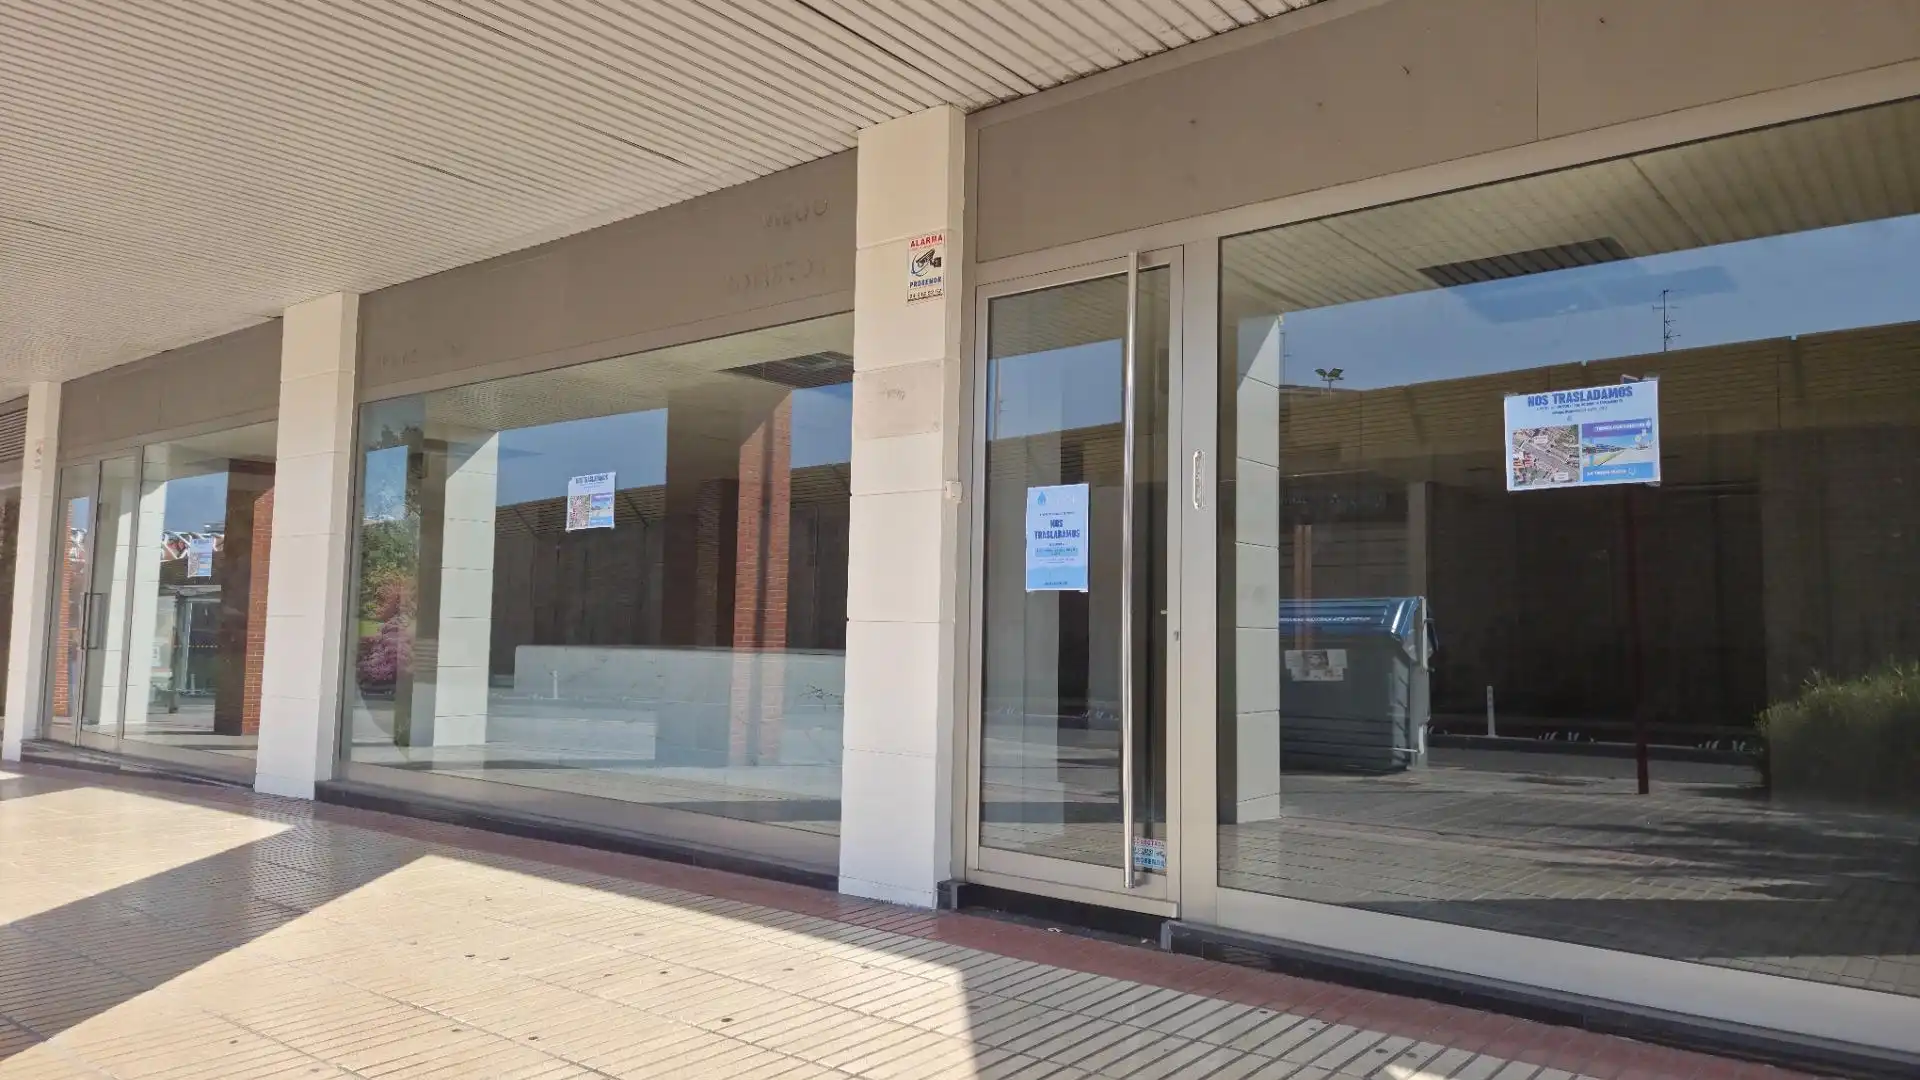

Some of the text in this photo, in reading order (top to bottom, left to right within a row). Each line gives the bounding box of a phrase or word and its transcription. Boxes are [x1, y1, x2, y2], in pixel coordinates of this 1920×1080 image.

[910, 234, 943, 248] ALARMA
[1527, 395, 1549, 407] NOS
[1551, 385, 1633, 405] TRASLADAMOS
[1050, 519, 1063, 528] NOS
[1034, 529, 1081, 540] TRASLADAMOS
